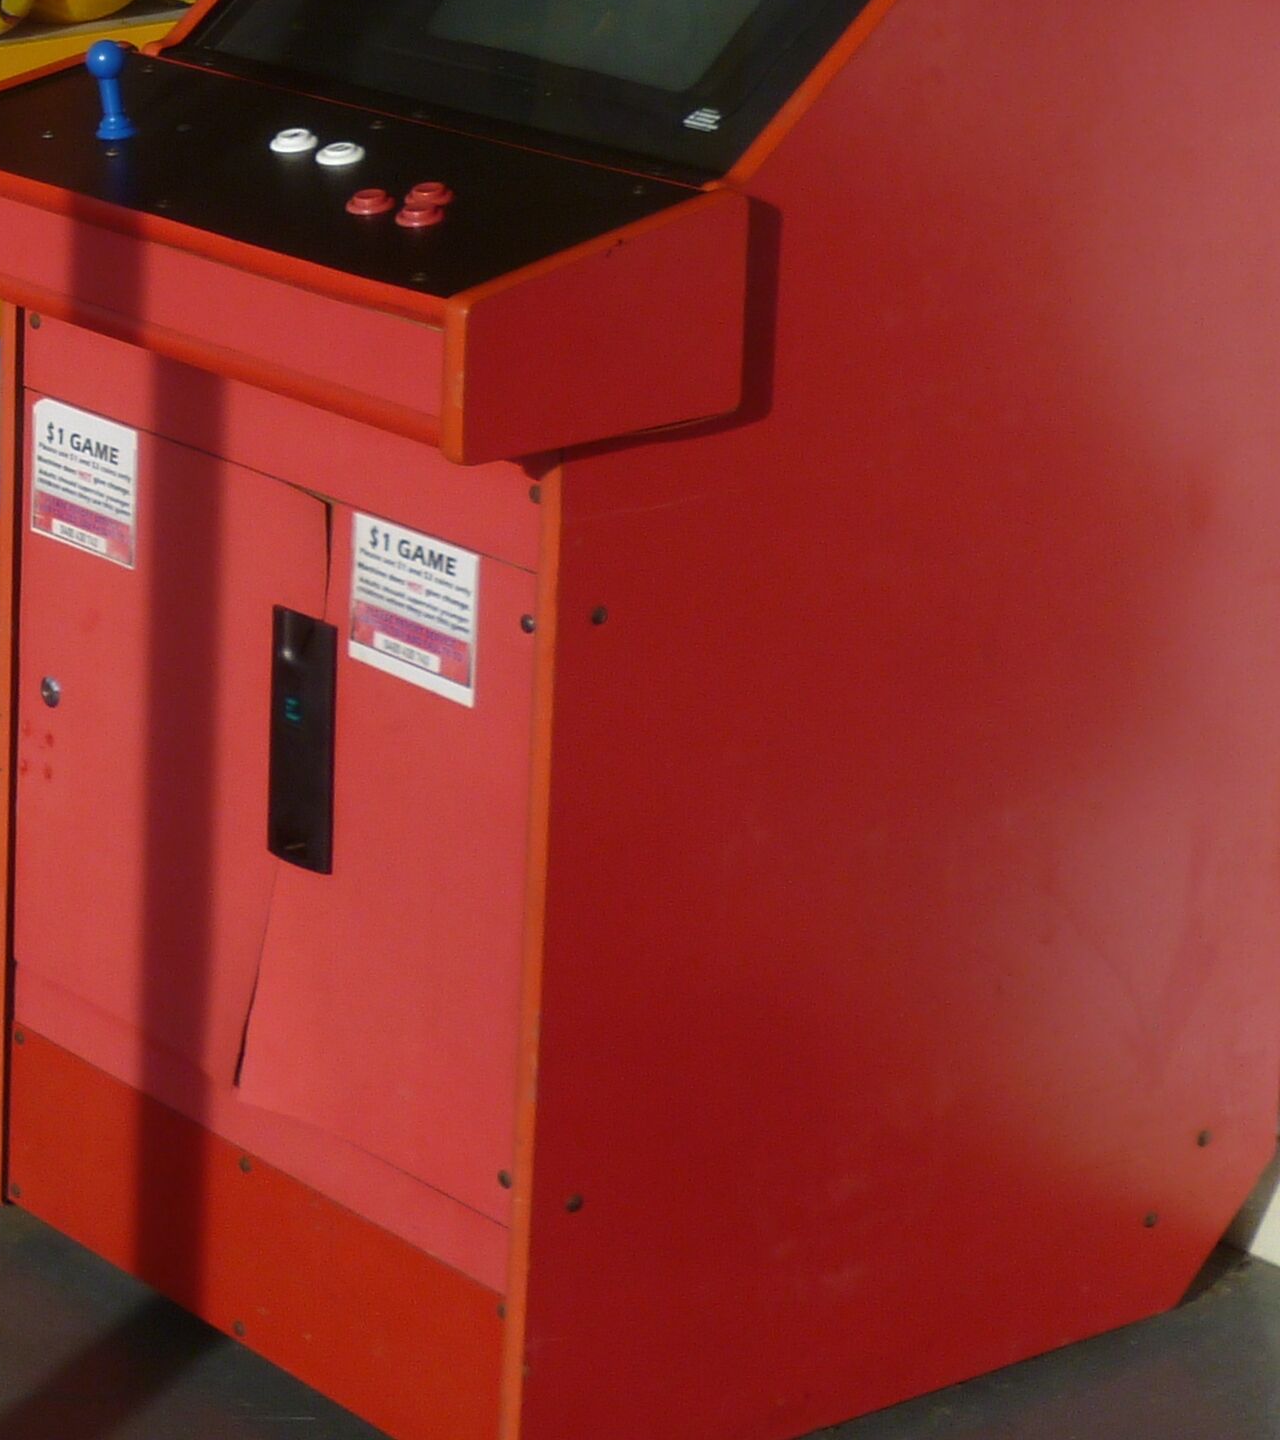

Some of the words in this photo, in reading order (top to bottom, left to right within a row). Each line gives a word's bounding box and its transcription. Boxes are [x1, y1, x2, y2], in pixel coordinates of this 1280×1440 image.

[46, 421, 63, 445] $1
[70, 433, 119, 465] GAME
[369, 526, 390, 552] $1
[397, 539, 457, 577] GAME
